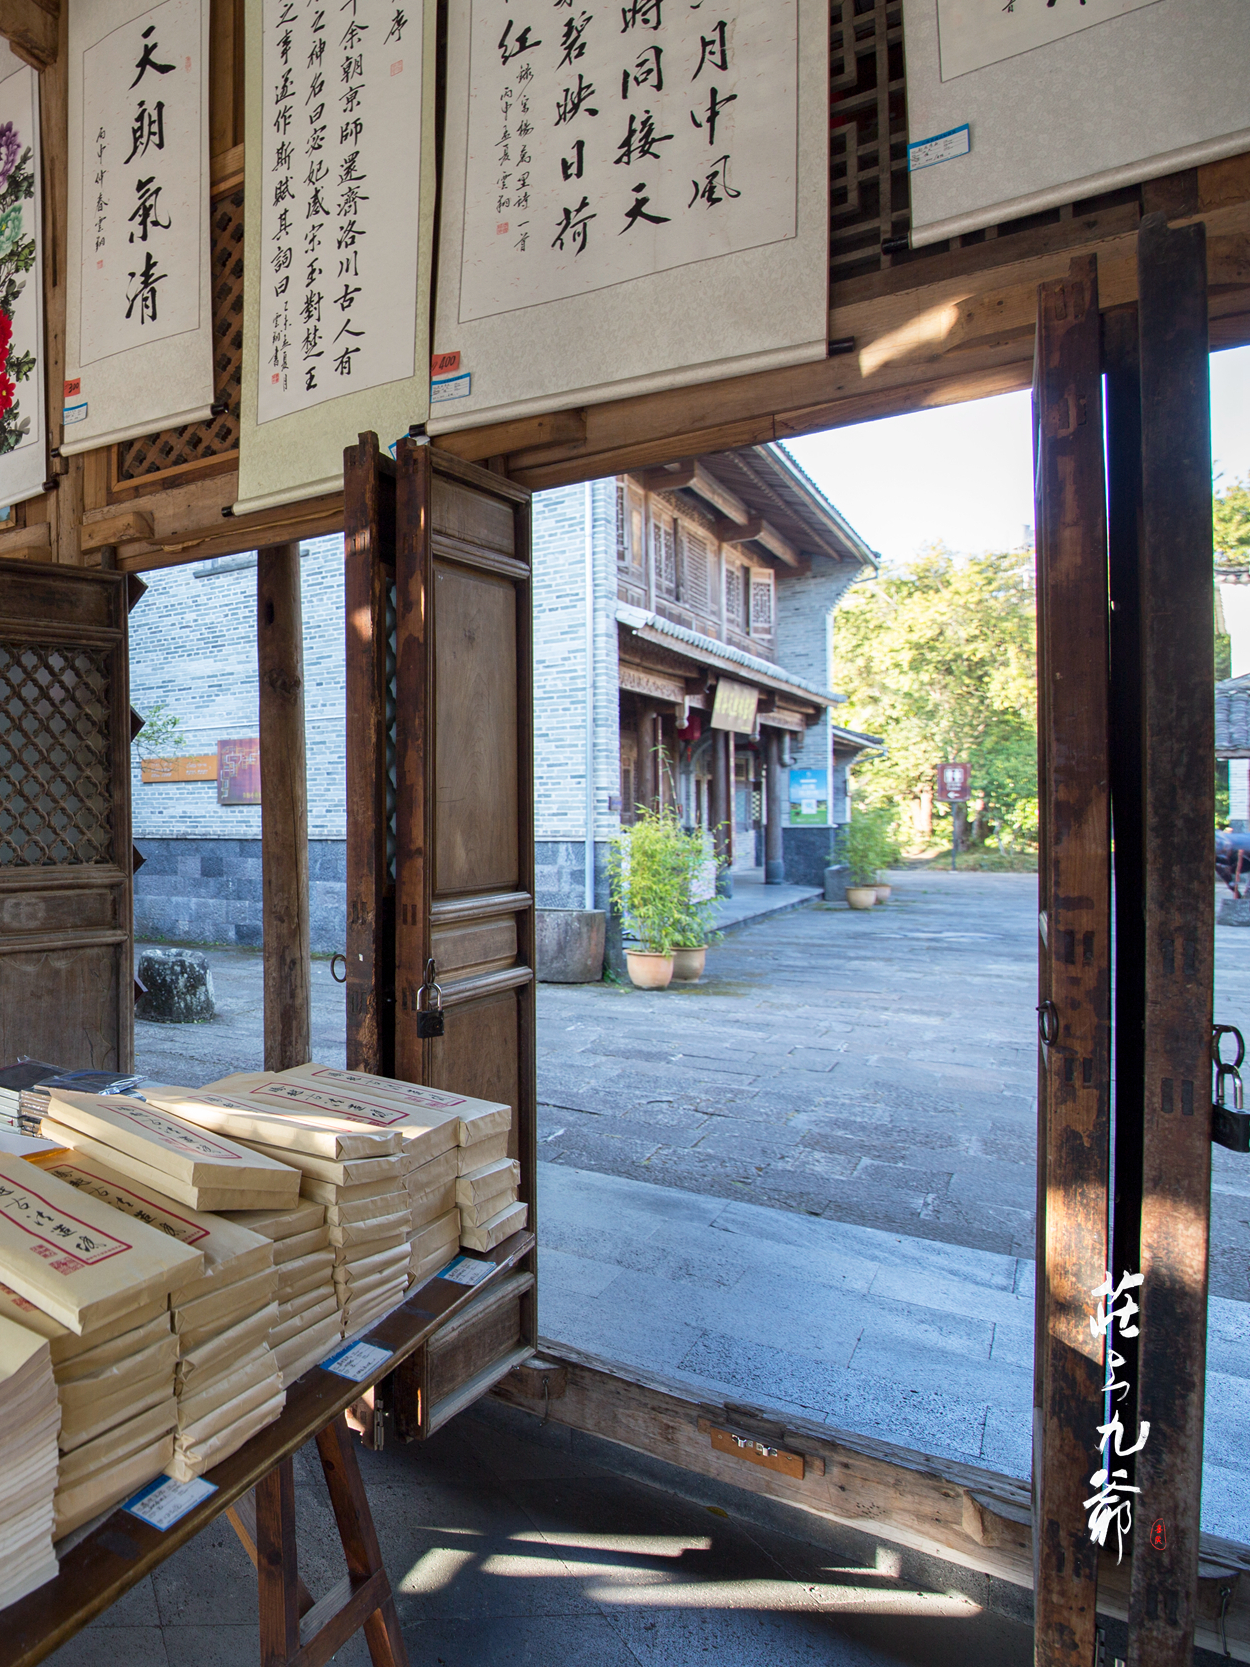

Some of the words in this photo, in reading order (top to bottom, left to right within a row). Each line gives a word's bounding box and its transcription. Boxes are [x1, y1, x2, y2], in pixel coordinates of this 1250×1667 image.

[551, 0, 599, 257] 碧映日荷
[688, 0, 741, 209] 月中風
